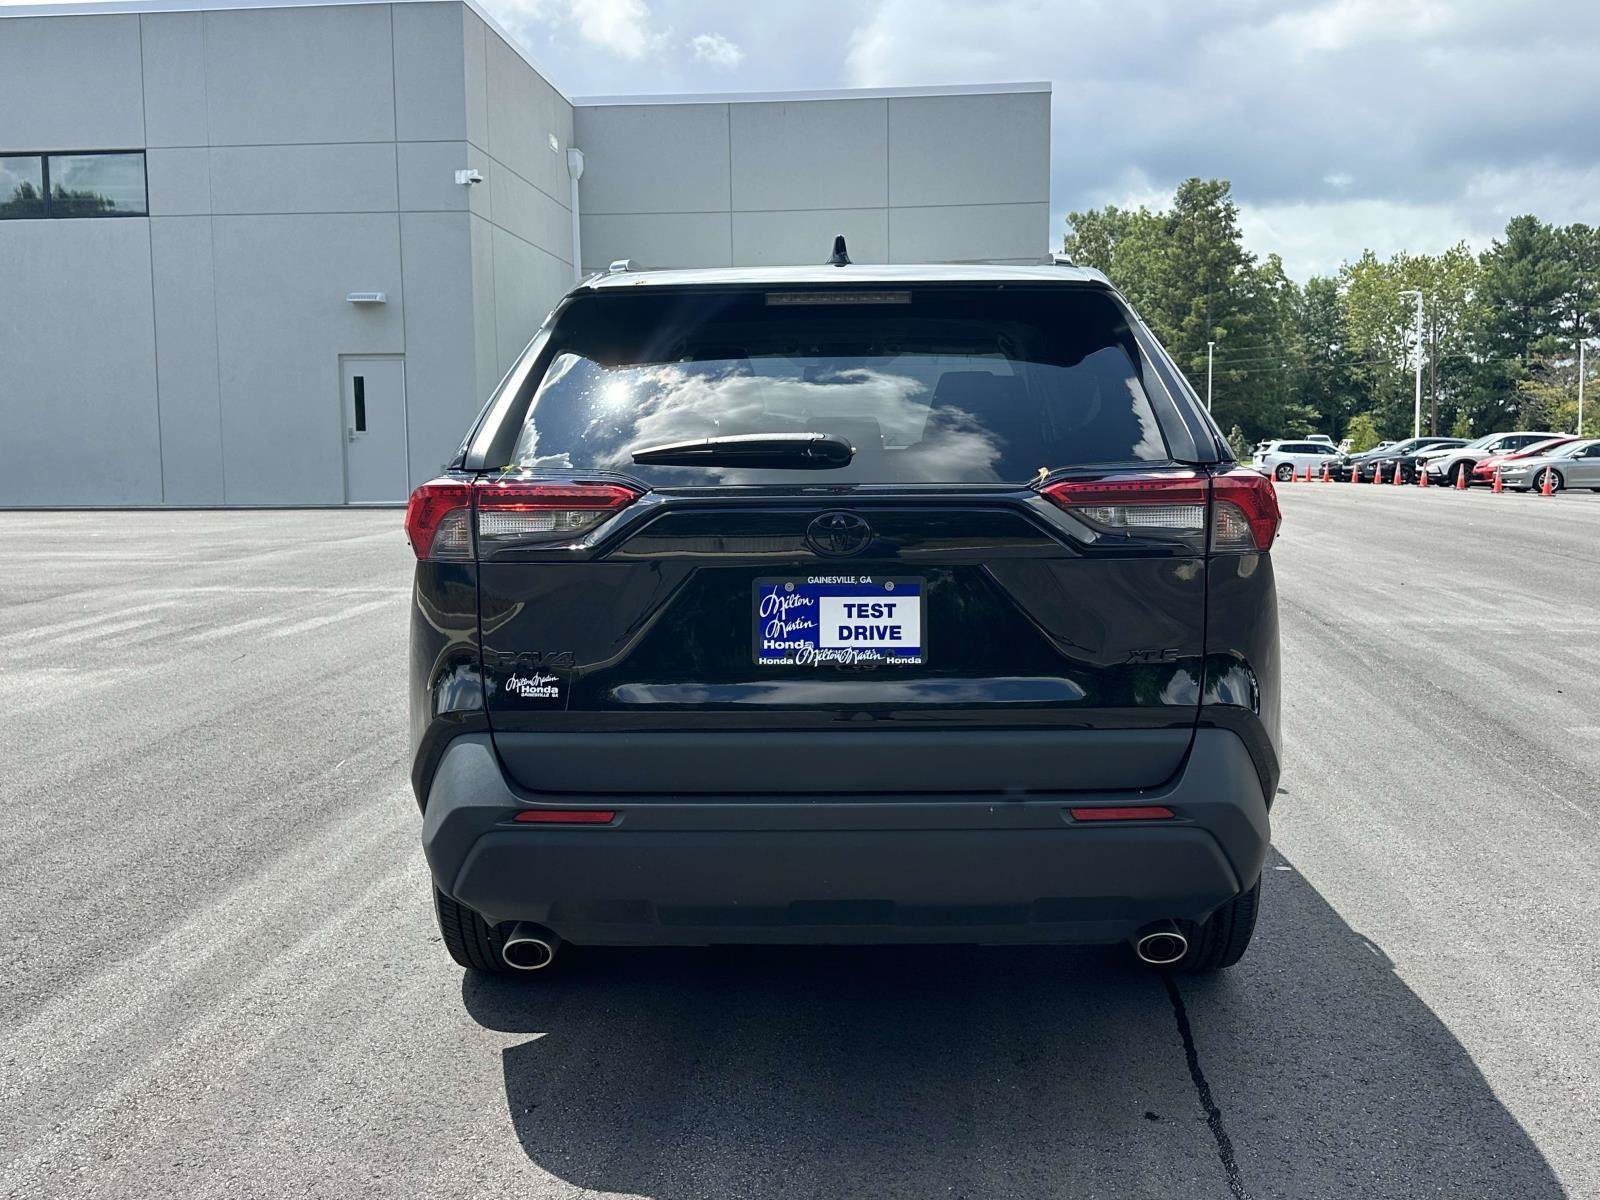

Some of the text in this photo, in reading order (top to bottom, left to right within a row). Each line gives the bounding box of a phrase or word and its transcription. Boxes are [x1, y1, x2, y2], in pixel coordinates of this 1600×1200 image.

[807, 576, 872, 585] GAINESVILLE, GA
[760, 585, 814, 619] Milton
[844, 603, 896, 618] TEST
[765, 613, 818, 638] Martin
[838, 625, 902, 640] DRIVE
[763, 640, 814, 650] Honda
[758, 657, 794, 665] Honda
[886, 656, 922, 664] Honda
[521, 685, 559, 693] Honda
